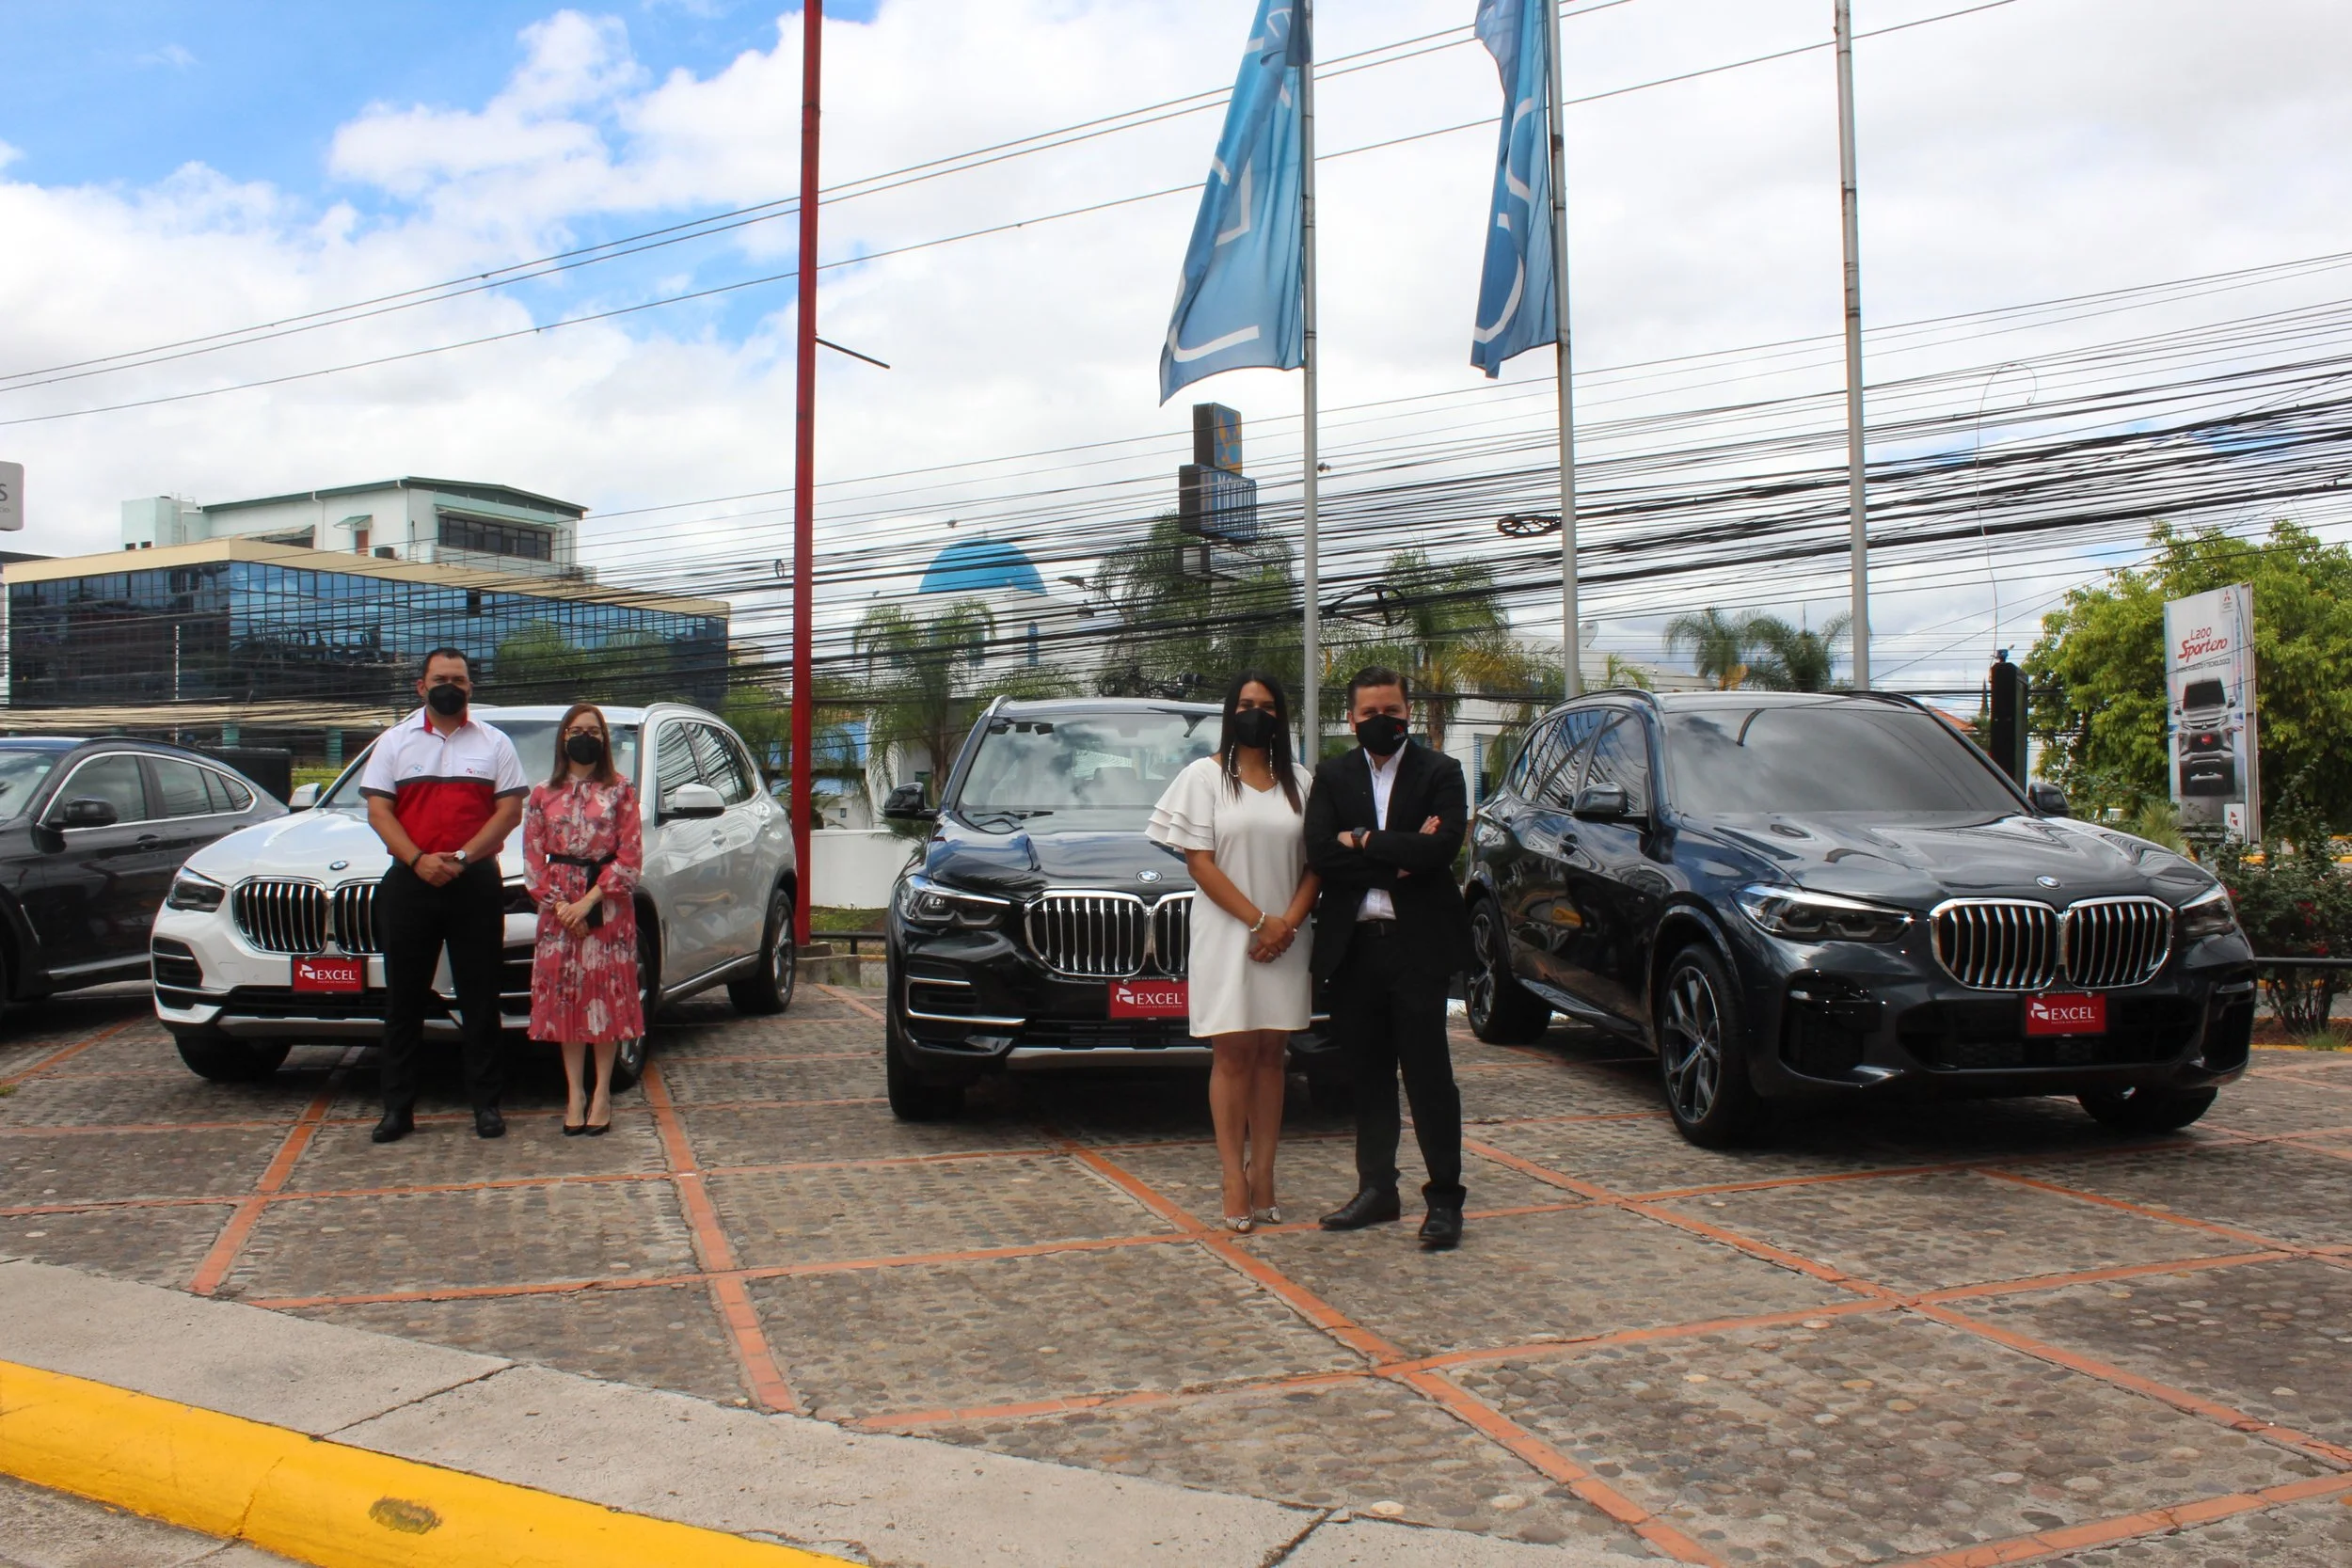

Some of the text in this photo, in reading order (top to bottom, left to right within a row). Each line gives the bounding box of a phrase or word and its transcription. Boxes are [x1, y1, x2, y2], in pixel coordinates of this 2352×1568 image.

[2190, 626, 2212, 641] L200
[2177, 638, 2228, 663] Sportero
[317, 969, 356, 980] EXCEL
[1136, 992, 1183, 1005] EXCEL
[2051, 1006, 2095, 1021] EXCEL
